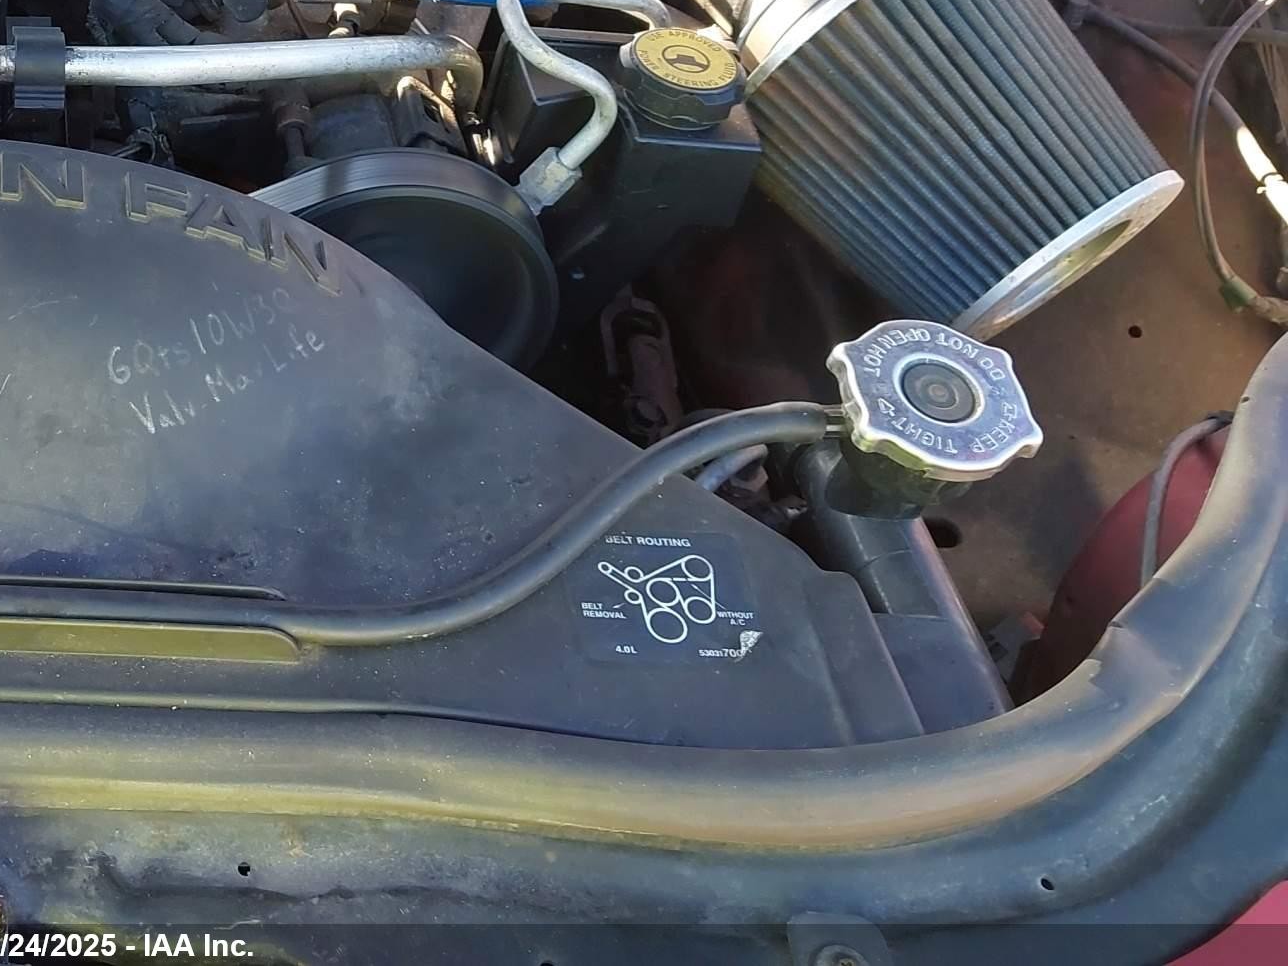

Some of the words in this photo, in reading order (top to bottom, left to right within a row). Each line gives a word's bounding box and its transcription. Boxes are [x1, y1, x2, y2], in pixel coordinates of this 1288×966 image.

[124, 172, 342, 297] FAN
[935, 332, 979, 359] NOT
[979, 357, 1006, 381] DO
[891, 417, 959, 455] TIGHT
[971, 420, 1016, 454] KEEP
[636, 536, 692, 547] ROUTING
[581, 602, 603, 611] BELT
[583, 610, 627, 620] REMOVAL
[717, 611, 754, 620] WITHOUT
